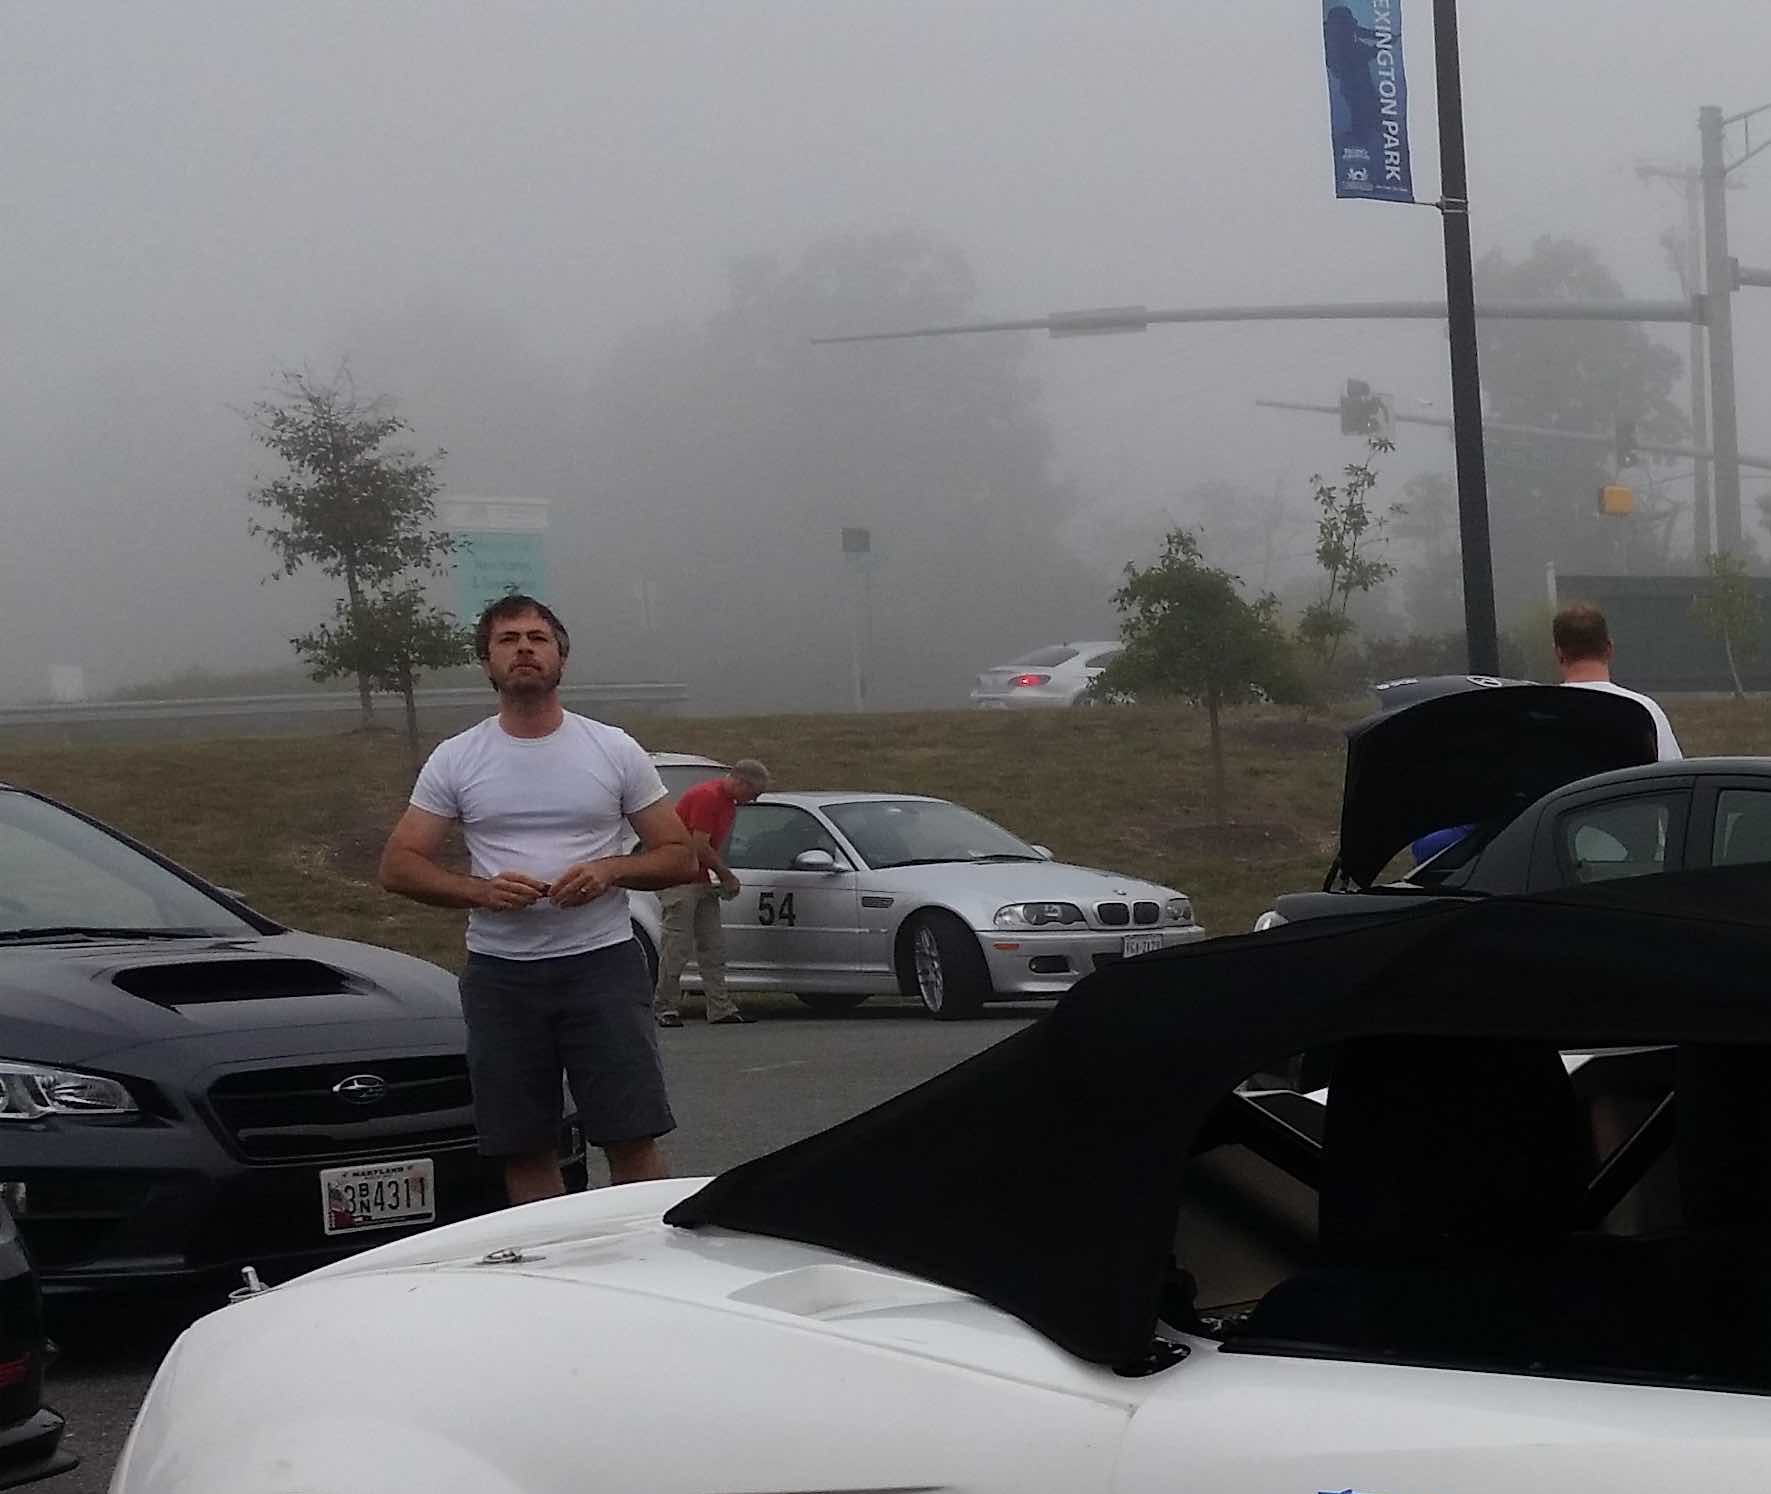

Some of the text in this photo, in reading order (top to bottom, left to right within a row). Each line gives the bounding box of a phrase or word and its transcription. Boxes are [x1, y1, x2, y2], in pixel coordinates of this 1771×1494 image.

[1382, 119, 1400, 181] PARK
[759, 891, 796, 927] 54
[353, 1167, 404, 1177] MARYLAND
